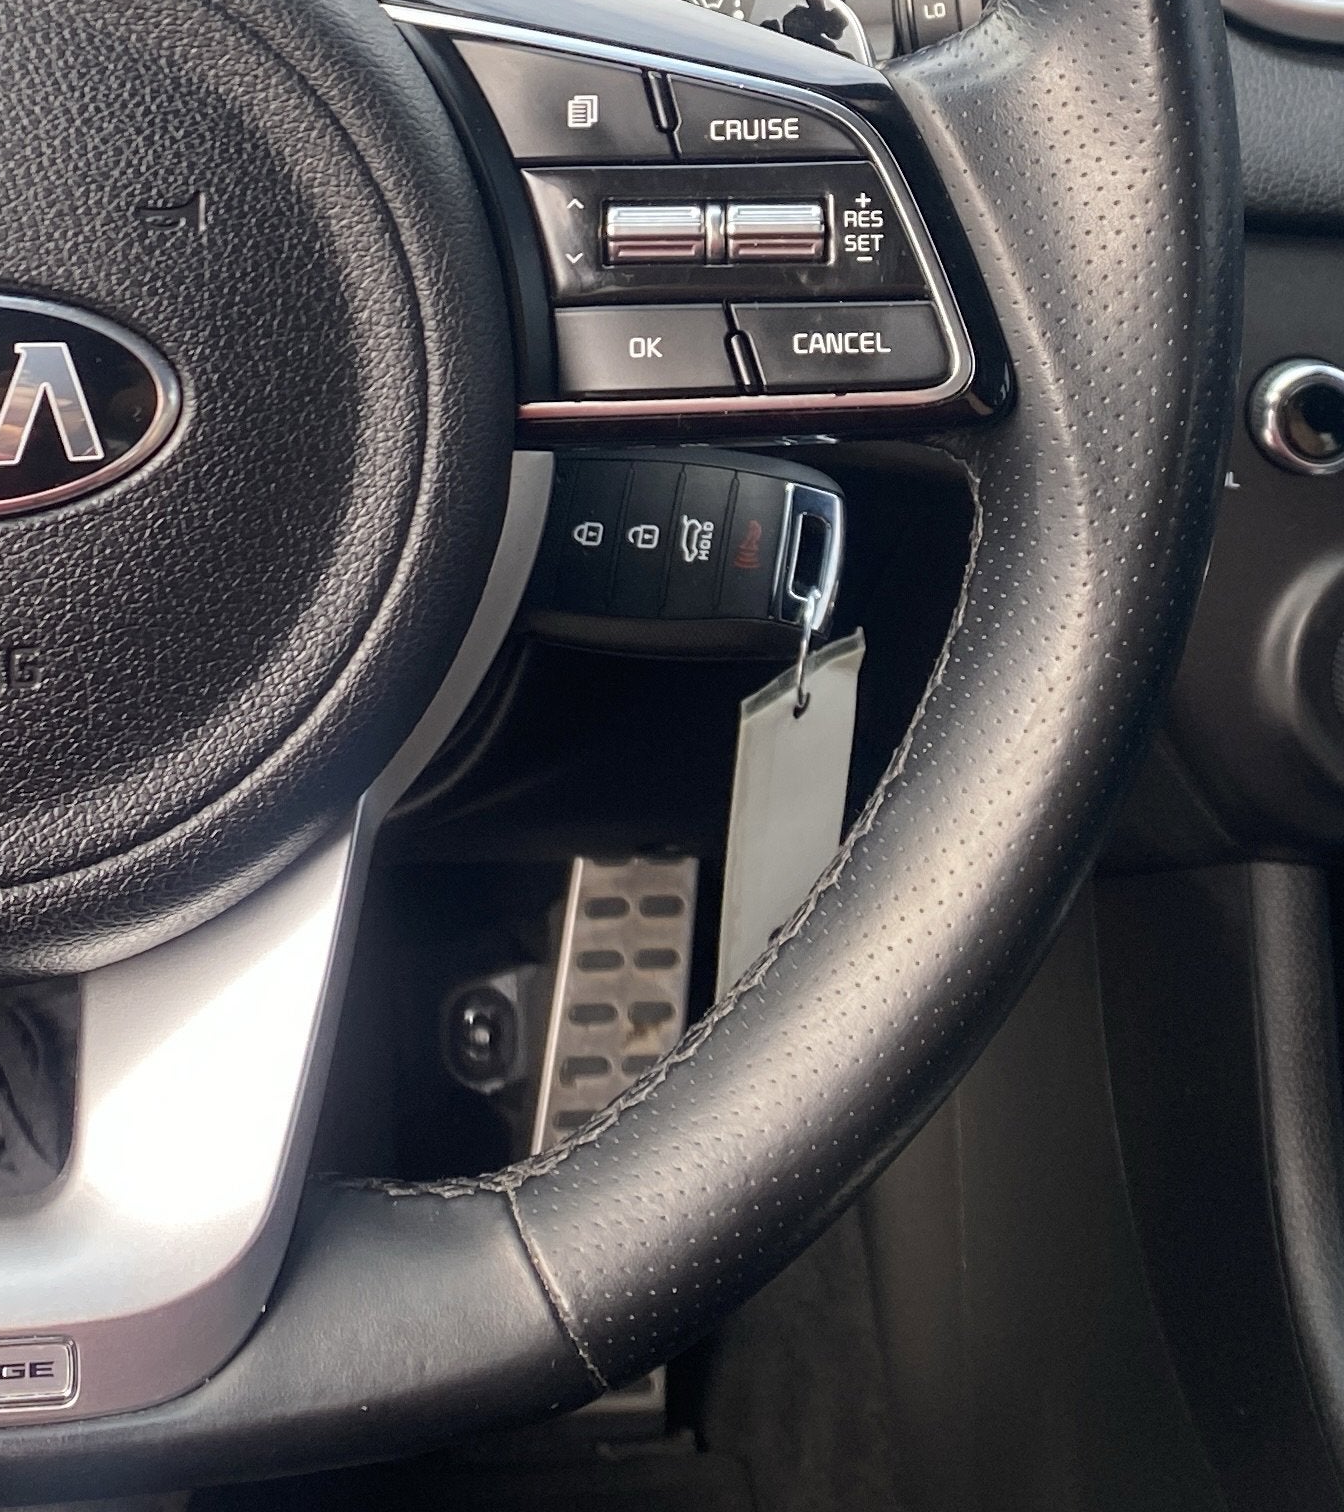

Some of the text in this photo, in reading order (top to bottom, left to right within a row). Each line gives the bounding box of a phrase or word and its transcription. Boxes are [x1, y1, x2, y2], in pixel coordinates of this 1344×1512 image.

[923, 2, 947, 20] LO
[709, 117, 800, 142] CRUISE
[843, 209, 884, 229] RES
[844, 233, 884, 253] SET
[629, 337, 664, 359] OK
[792, 331, 891, 356] CANCEL
[697, 520, 715, 561] HOLD
